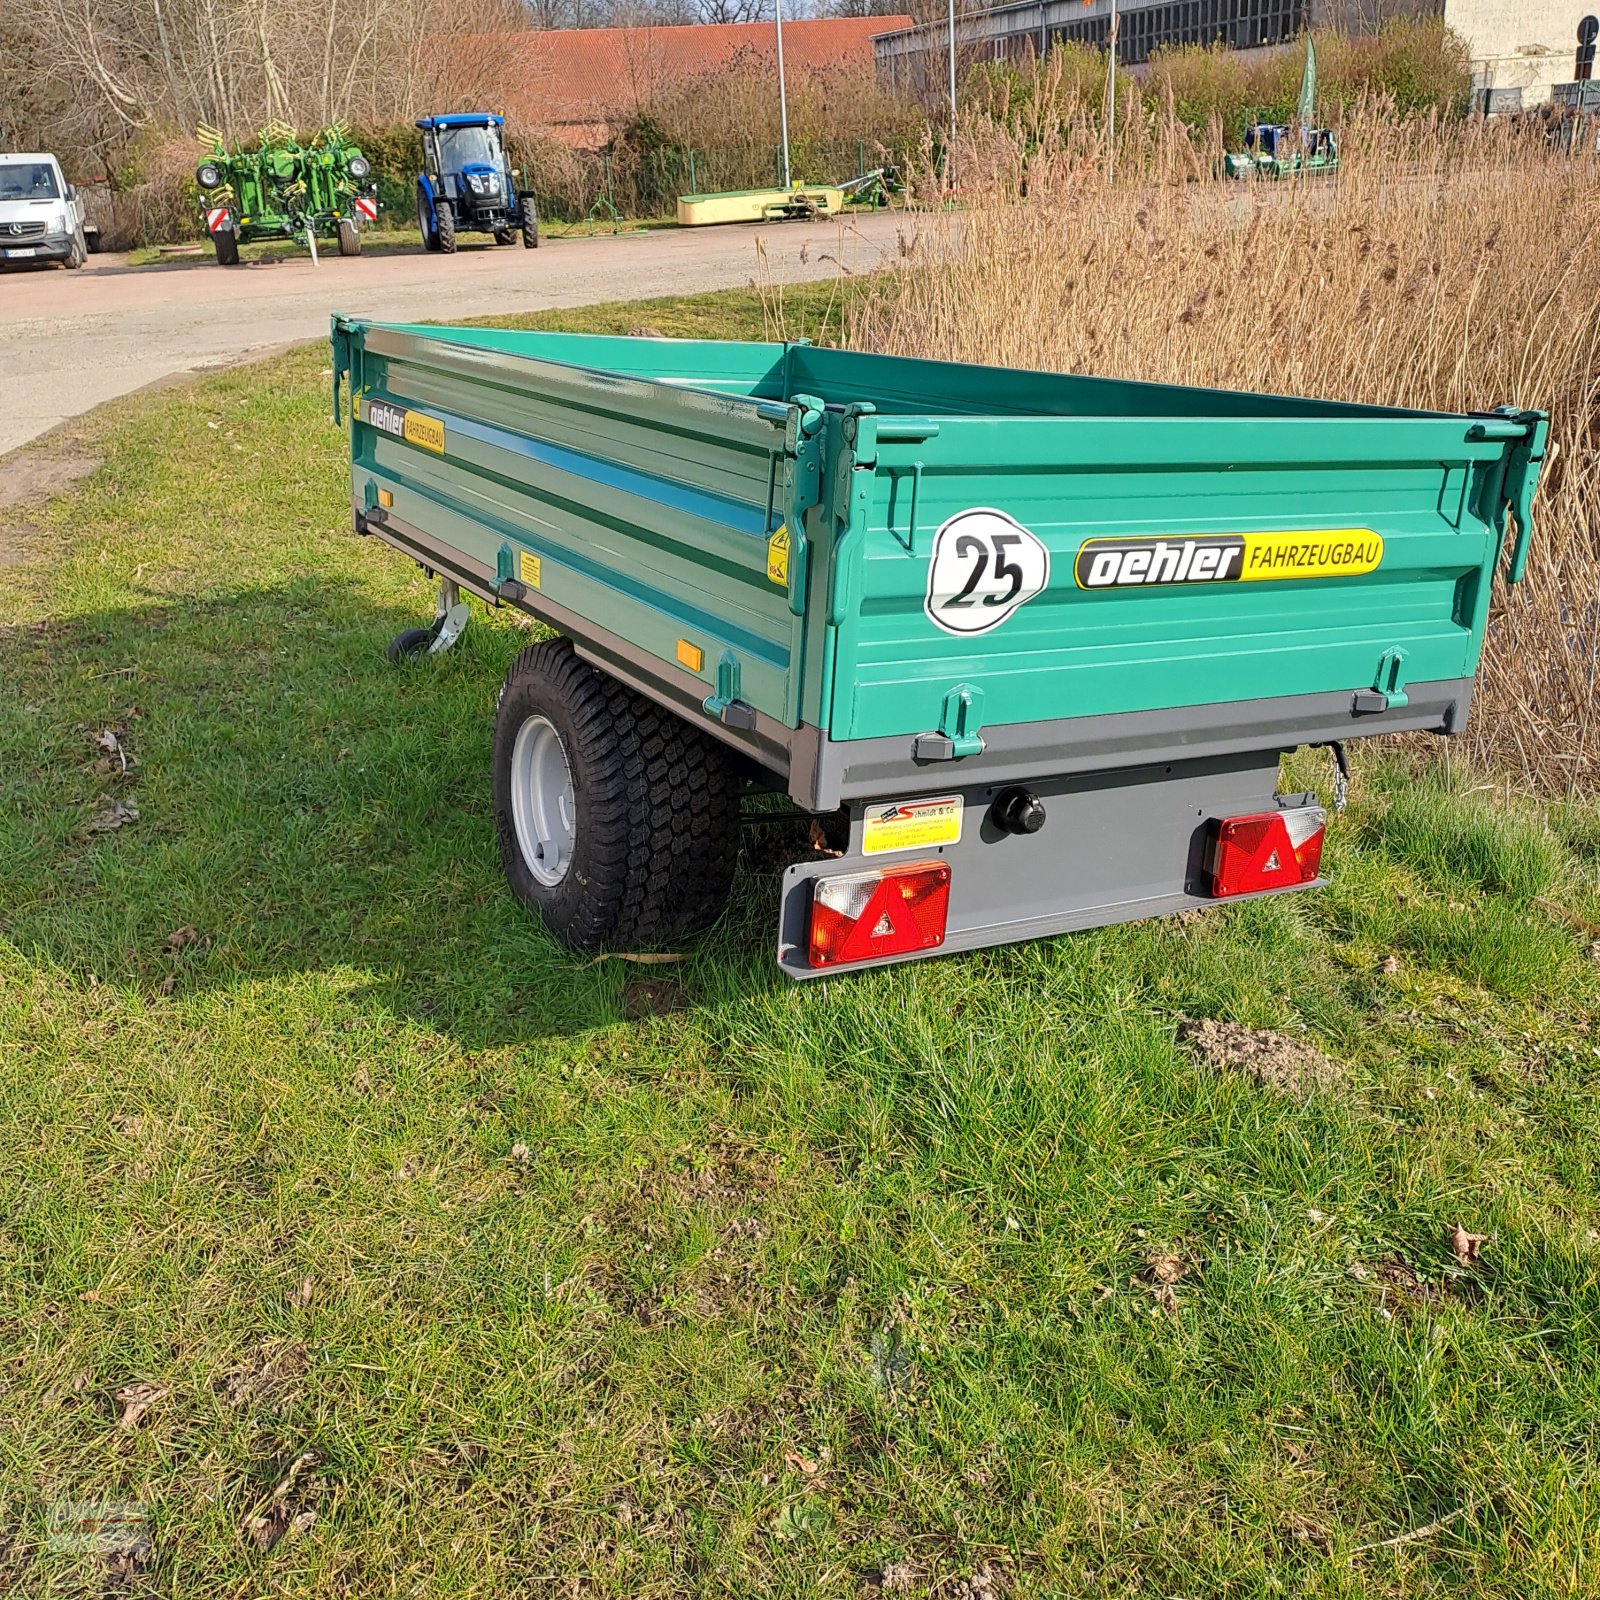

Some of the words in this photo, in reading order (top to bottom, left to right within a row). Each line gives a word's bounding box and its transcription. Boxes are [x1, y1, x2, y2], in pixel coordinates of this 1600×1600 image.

[370, 405, 405, 437] oehler
[406, 419, 444, 448] FAHRZEUGBAU
[940, 534, 1024, 609] 25
[1087, 540, 1241, 586] oehler
[1249, 541, 1379, 569] FAHRZEUGBAU
